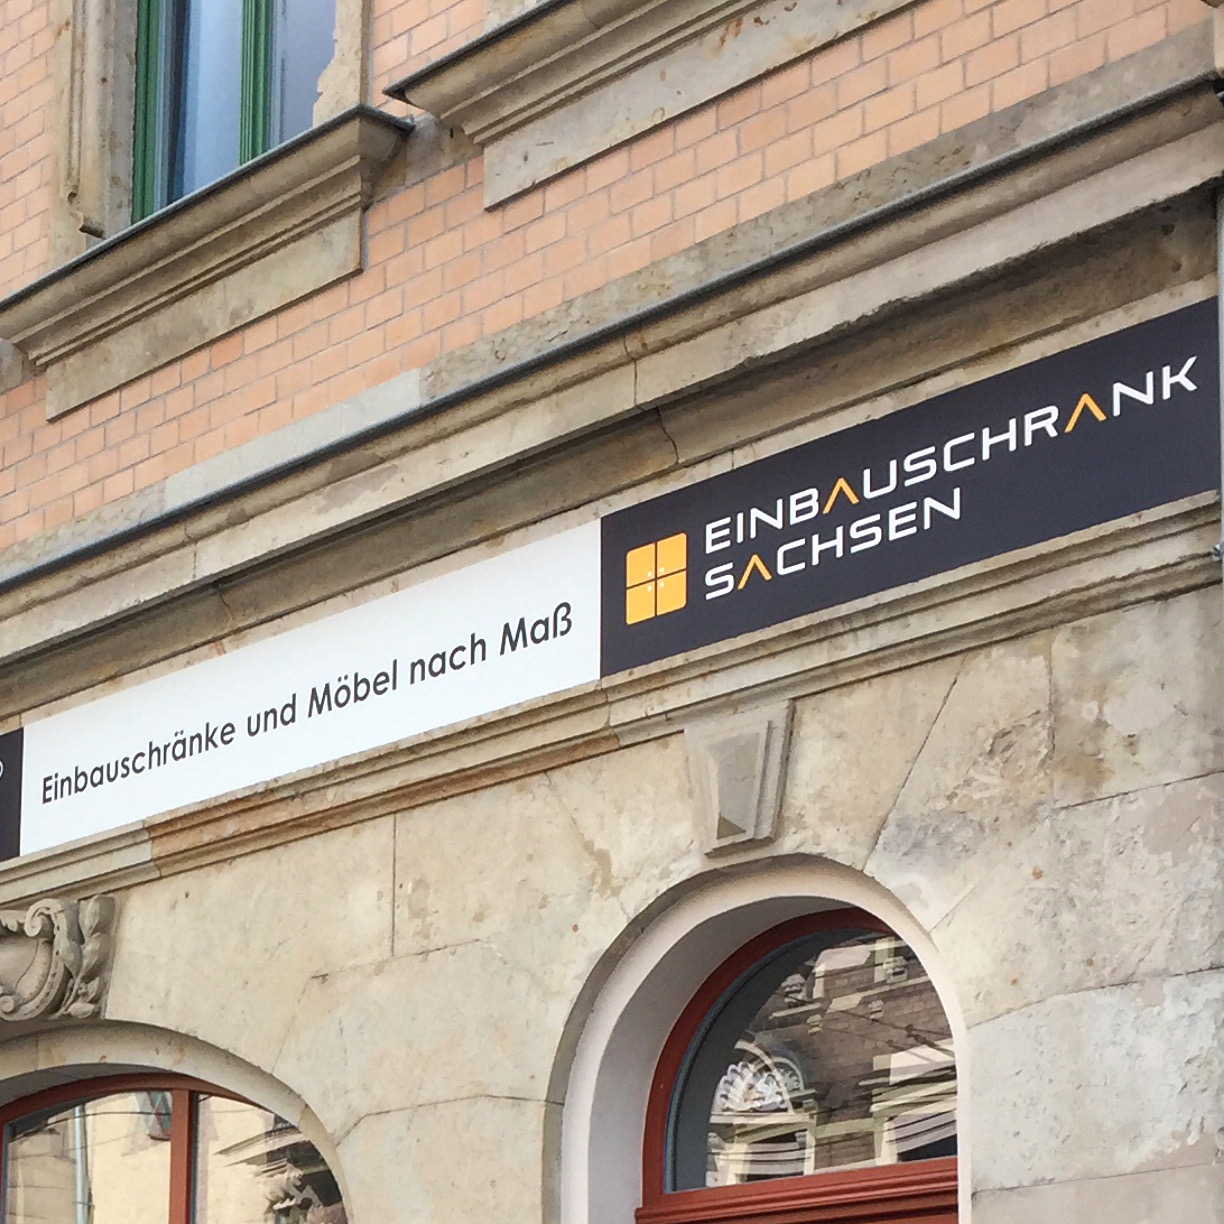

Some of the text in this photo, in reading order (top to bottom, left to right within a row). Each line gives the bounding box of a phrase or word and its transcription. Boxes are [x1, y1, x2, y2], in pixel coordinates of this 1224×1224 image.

[704, 355, 1198, 554] EINBAUSCHRANK
[704, 487, 962, 601] SACHSEN
[42, 602, 574, 804] Einbauschränke und Möbel nach Maß
